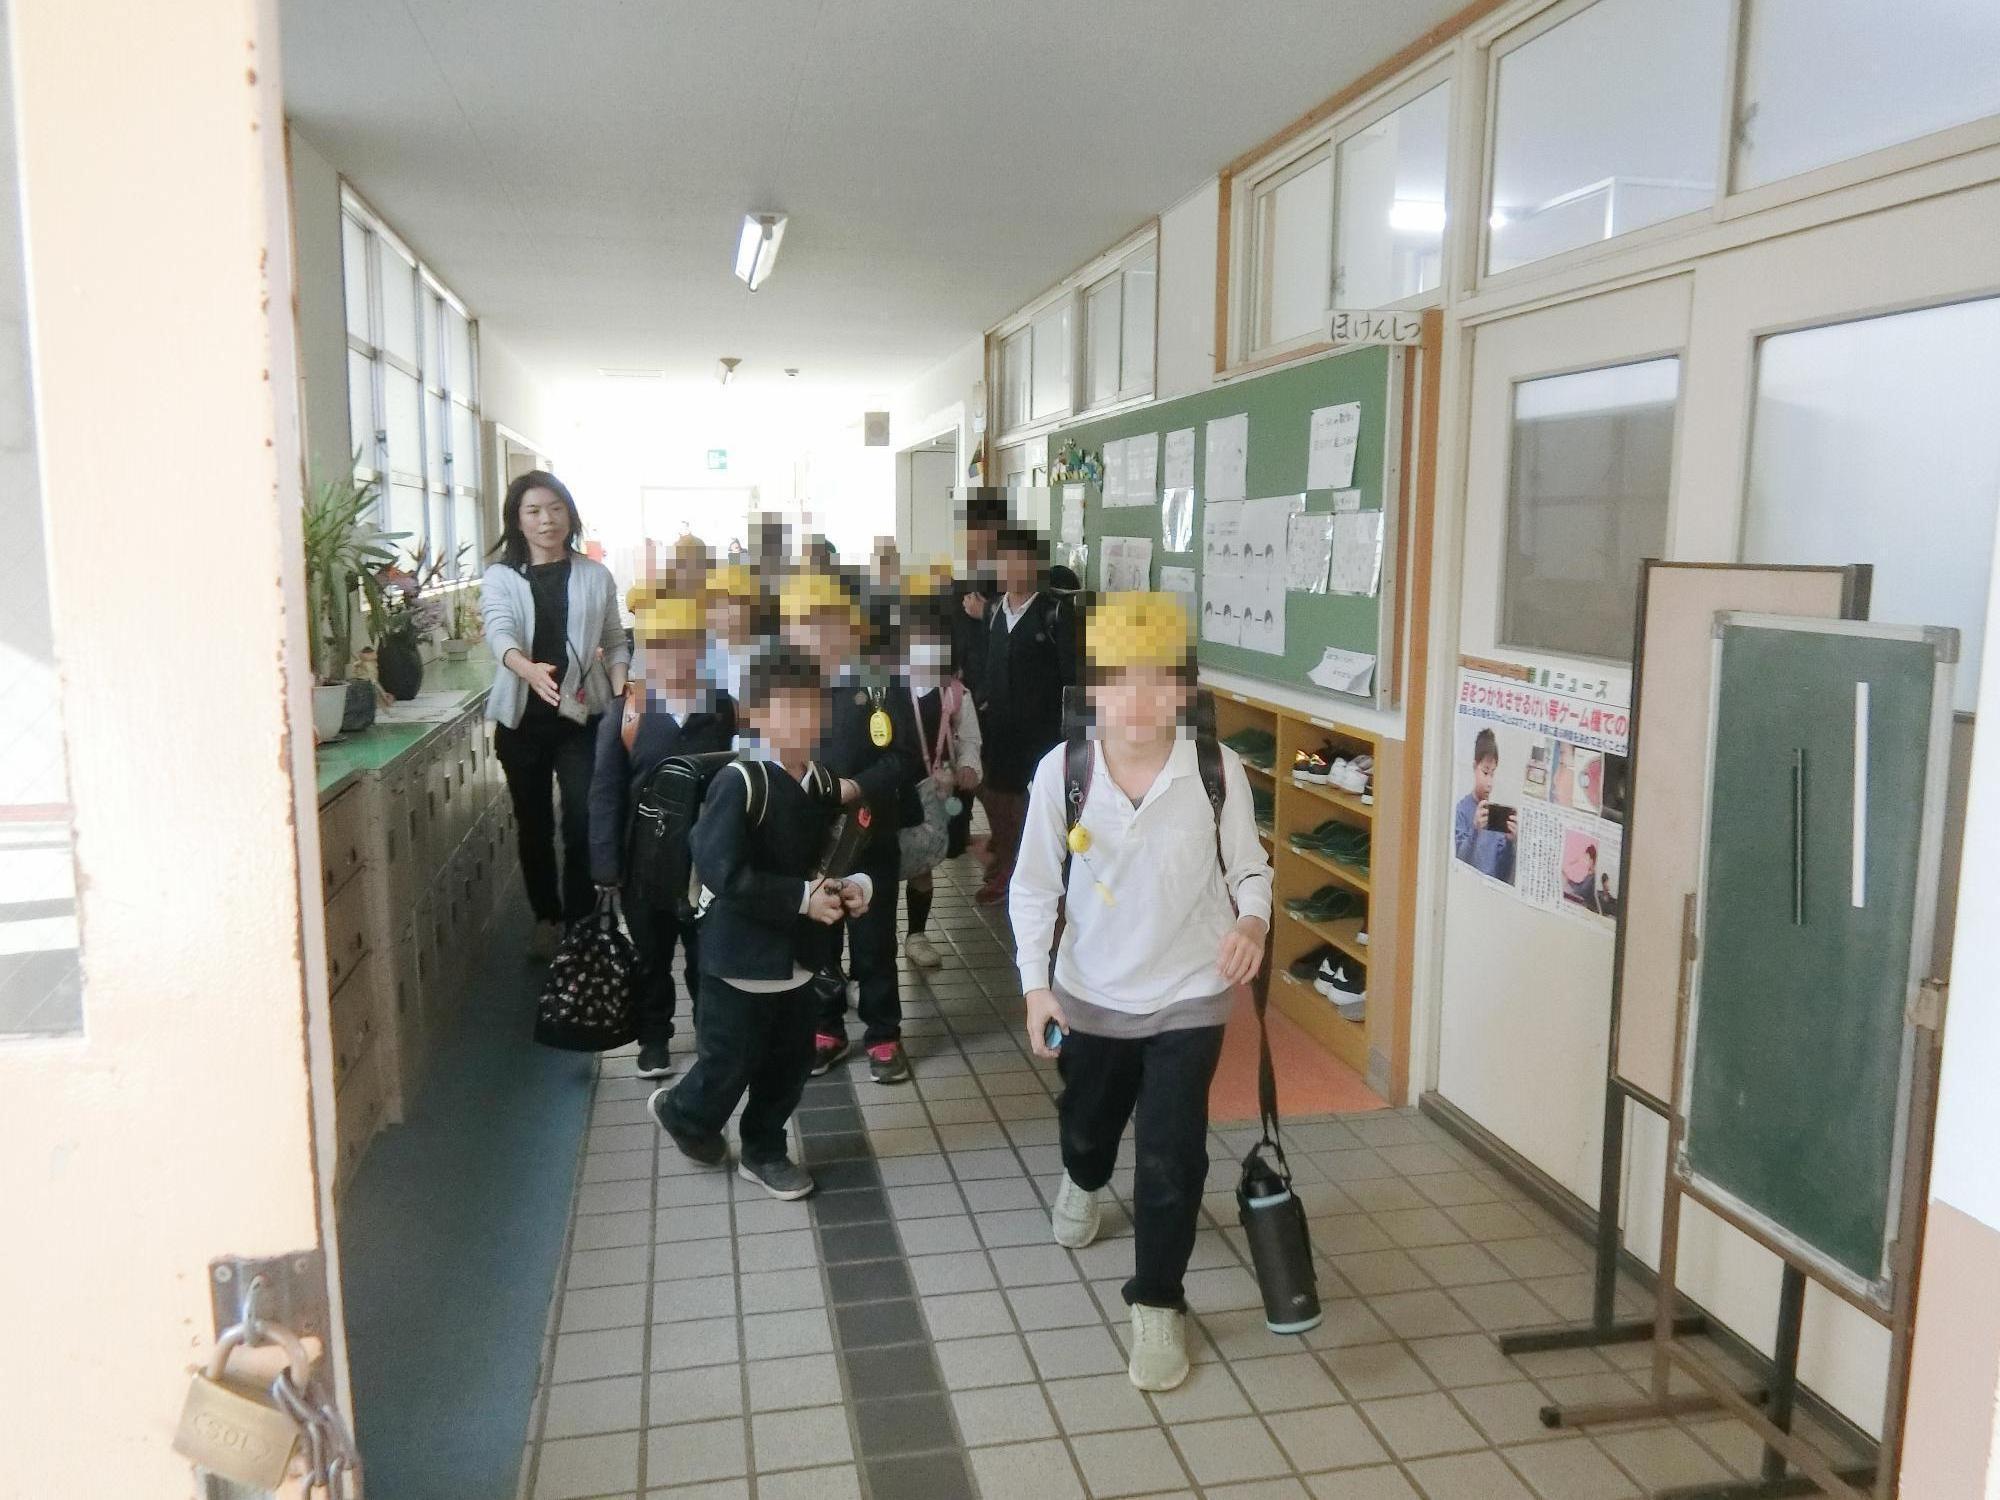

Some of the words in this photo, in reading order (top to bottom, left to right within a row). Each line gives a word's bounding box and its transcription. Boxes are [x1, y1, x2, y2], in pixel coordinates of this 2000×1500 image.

[1331, 313, 1421, 341] ほけんしつ
